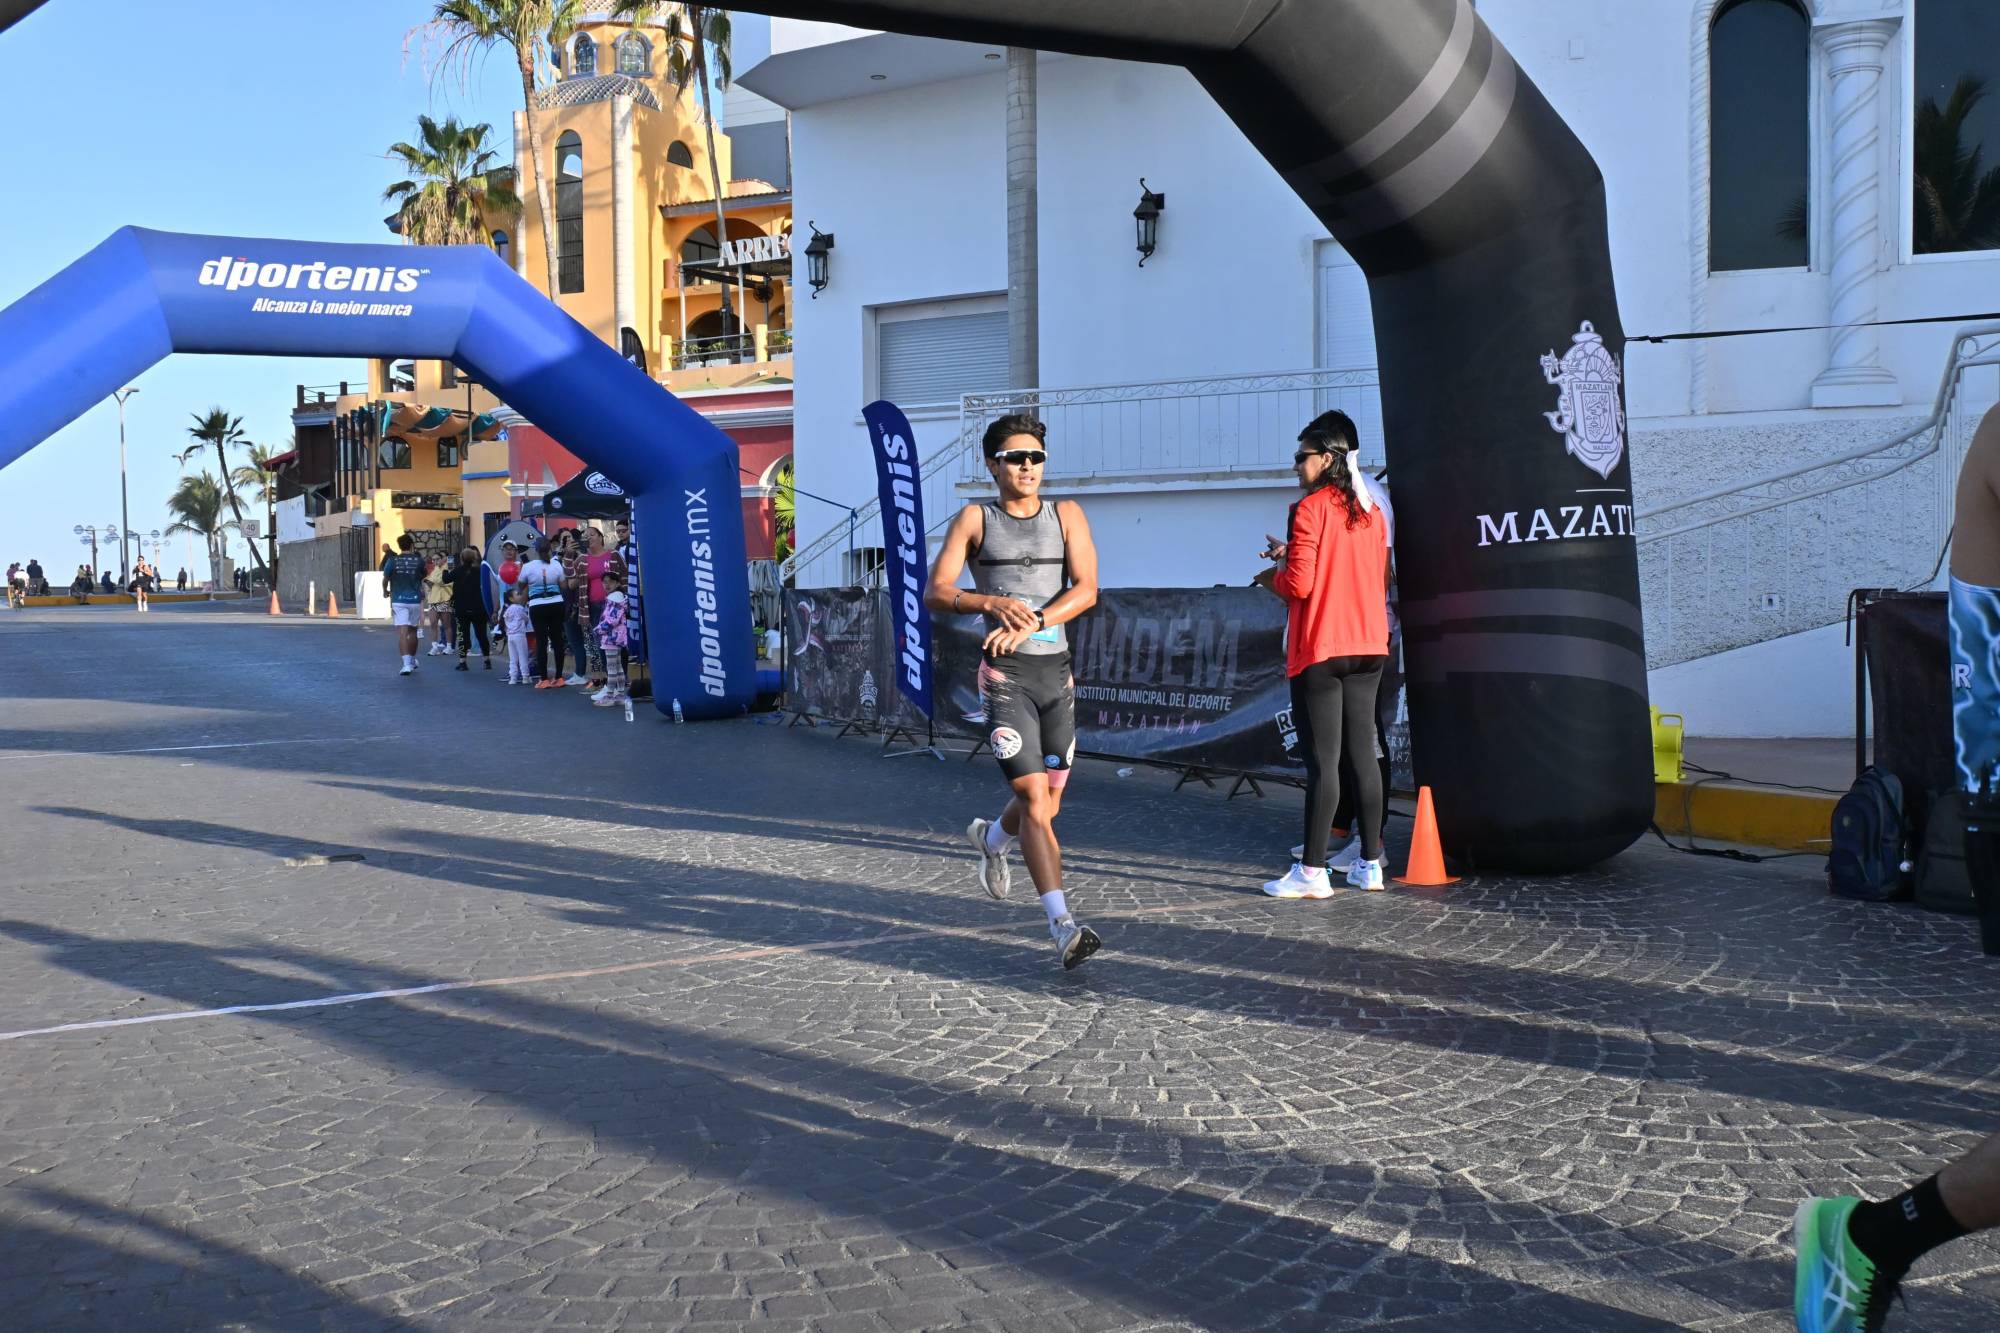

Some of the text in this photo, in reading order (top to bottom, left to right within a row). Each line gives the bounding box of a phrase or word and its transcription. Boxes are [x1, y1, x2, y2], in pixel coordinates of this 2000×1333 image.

[199, 256, 420, 293] dportenis
[252, 297, 412, 316] Alcanza la mejor marca
[883, 433, 925, 691] dportenis
[685, 488, 726, 697] dportenis.mx
[1074, 617, 1242, 688] IMDEM
[1118, 688, 1168, 706] MUNICIPAL
[1169, 693, 1186, 708] DEL
[1188, 693, 1232, 711] DEPORTE
